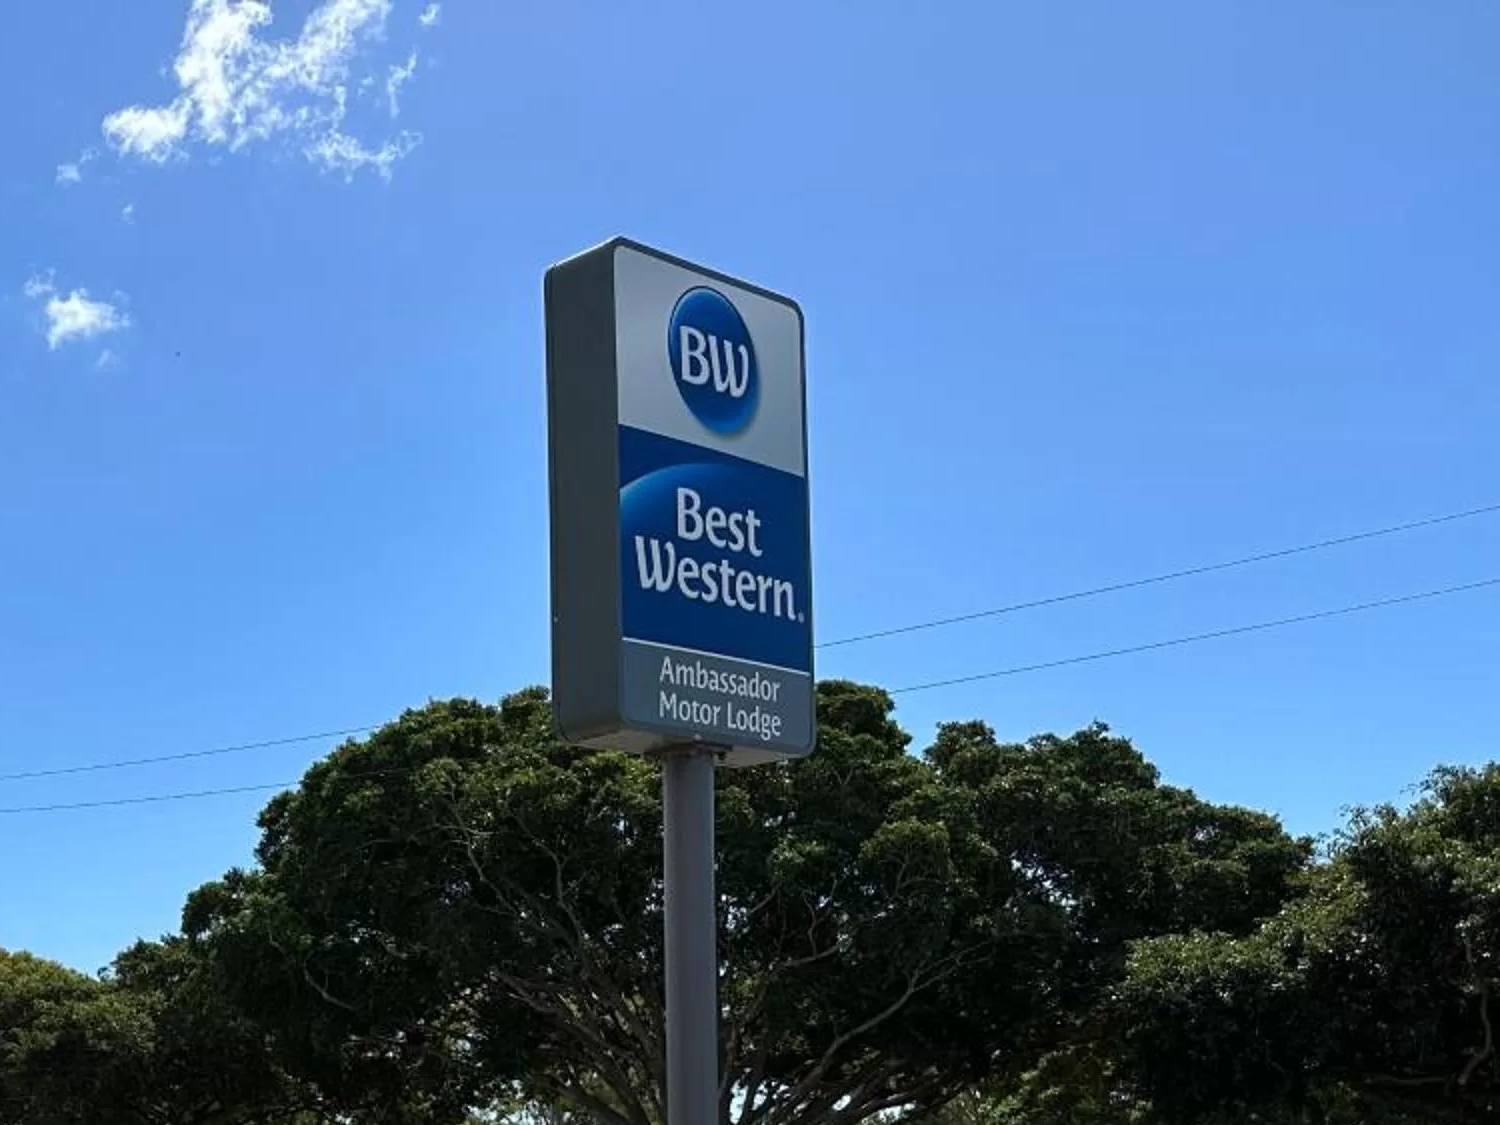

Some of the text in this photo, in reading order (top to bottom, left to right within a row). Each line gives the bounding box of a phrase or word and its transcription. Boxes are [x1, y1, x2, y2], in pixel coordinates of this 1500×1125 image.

[679, 325, 750, 398] BW
[676, 486, 763, 557] Best
[659, 655, 781, 703] Ambassador
[659, 690, 783, 742] Motor Lodge
